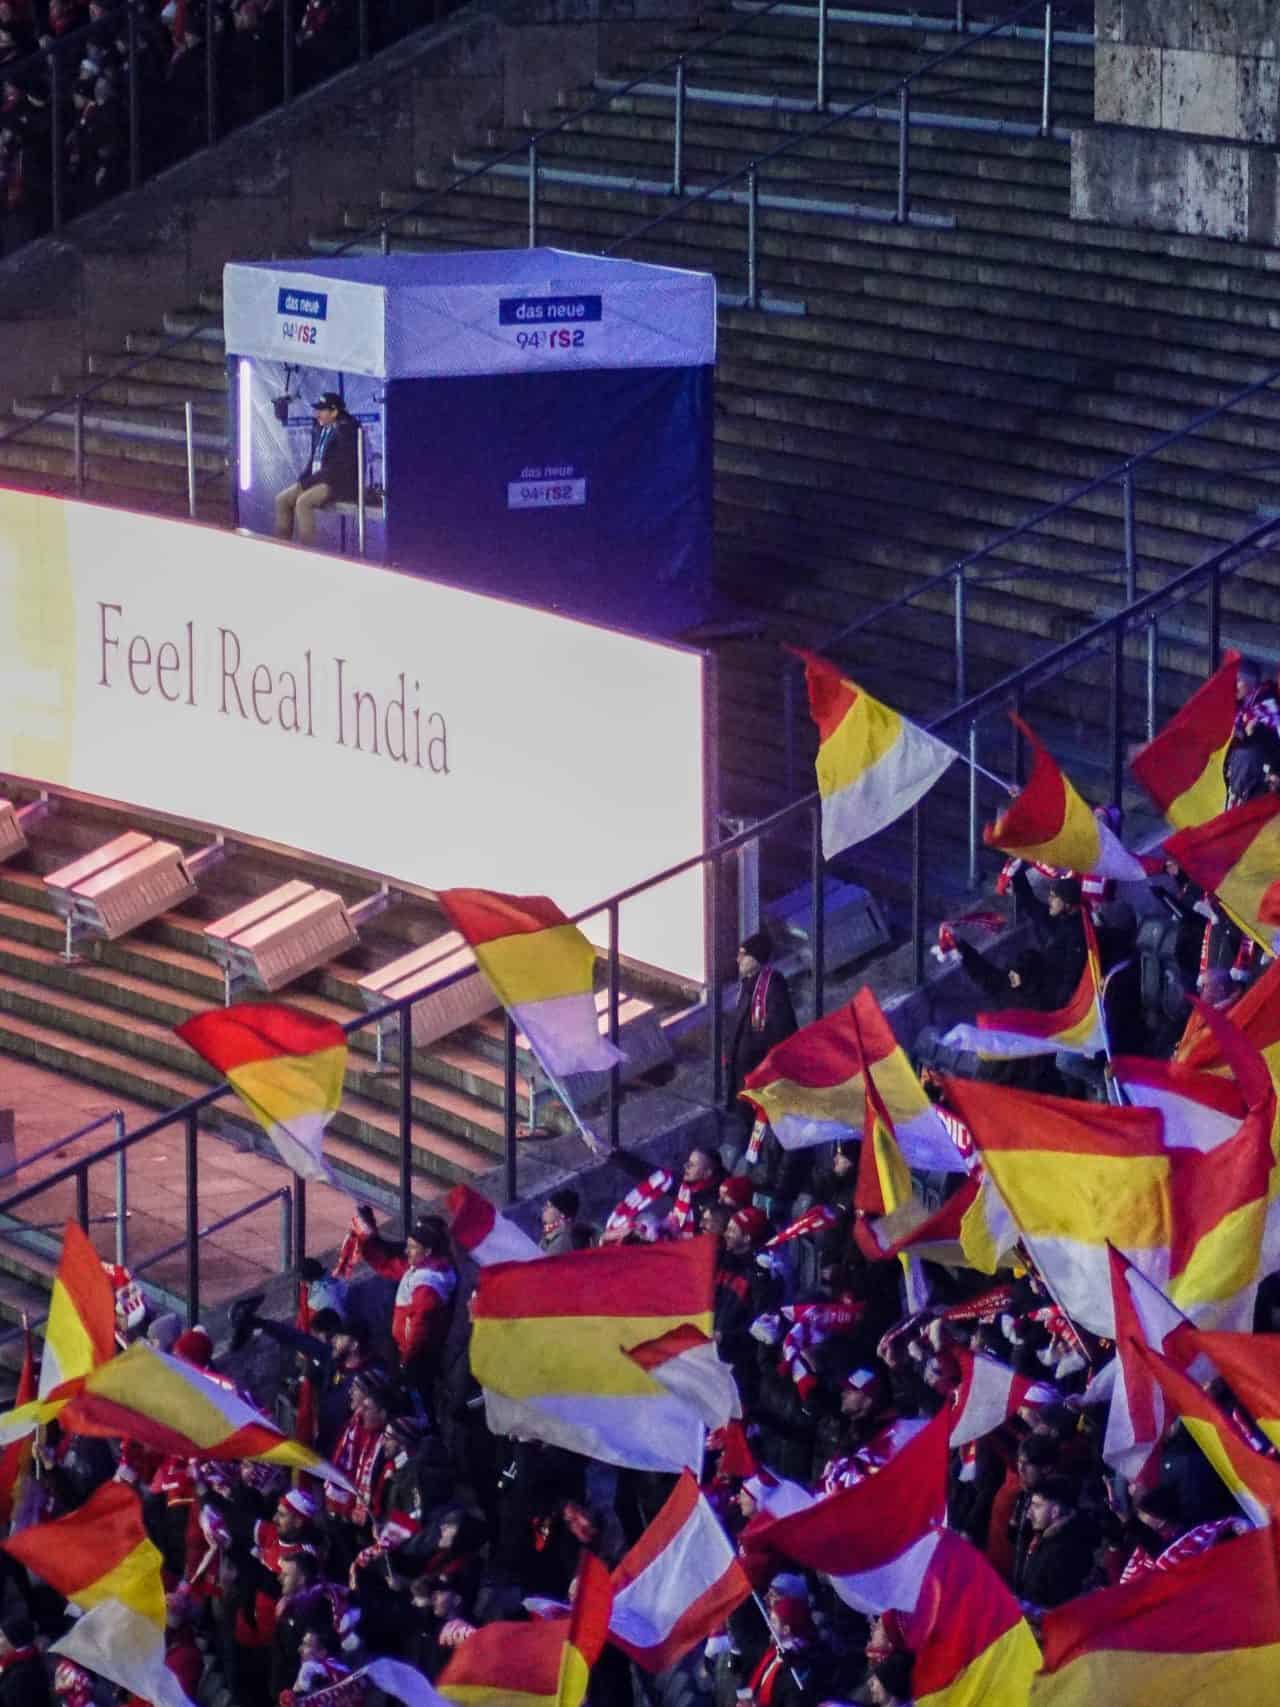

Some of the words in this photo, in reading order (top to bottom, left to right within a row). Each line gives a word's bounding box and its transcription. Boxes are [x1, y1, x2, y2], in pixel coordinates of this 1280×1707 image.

[285, 294, 299, 311] das
[300, 298, 320, 314] neue
[515, 303, 543, 320] das
[547, 302, 585, 318] neue
[96, 600, 198, 706] Feel
[217, 626, 317, 738] Real
[333, 656, 451, 775] India
